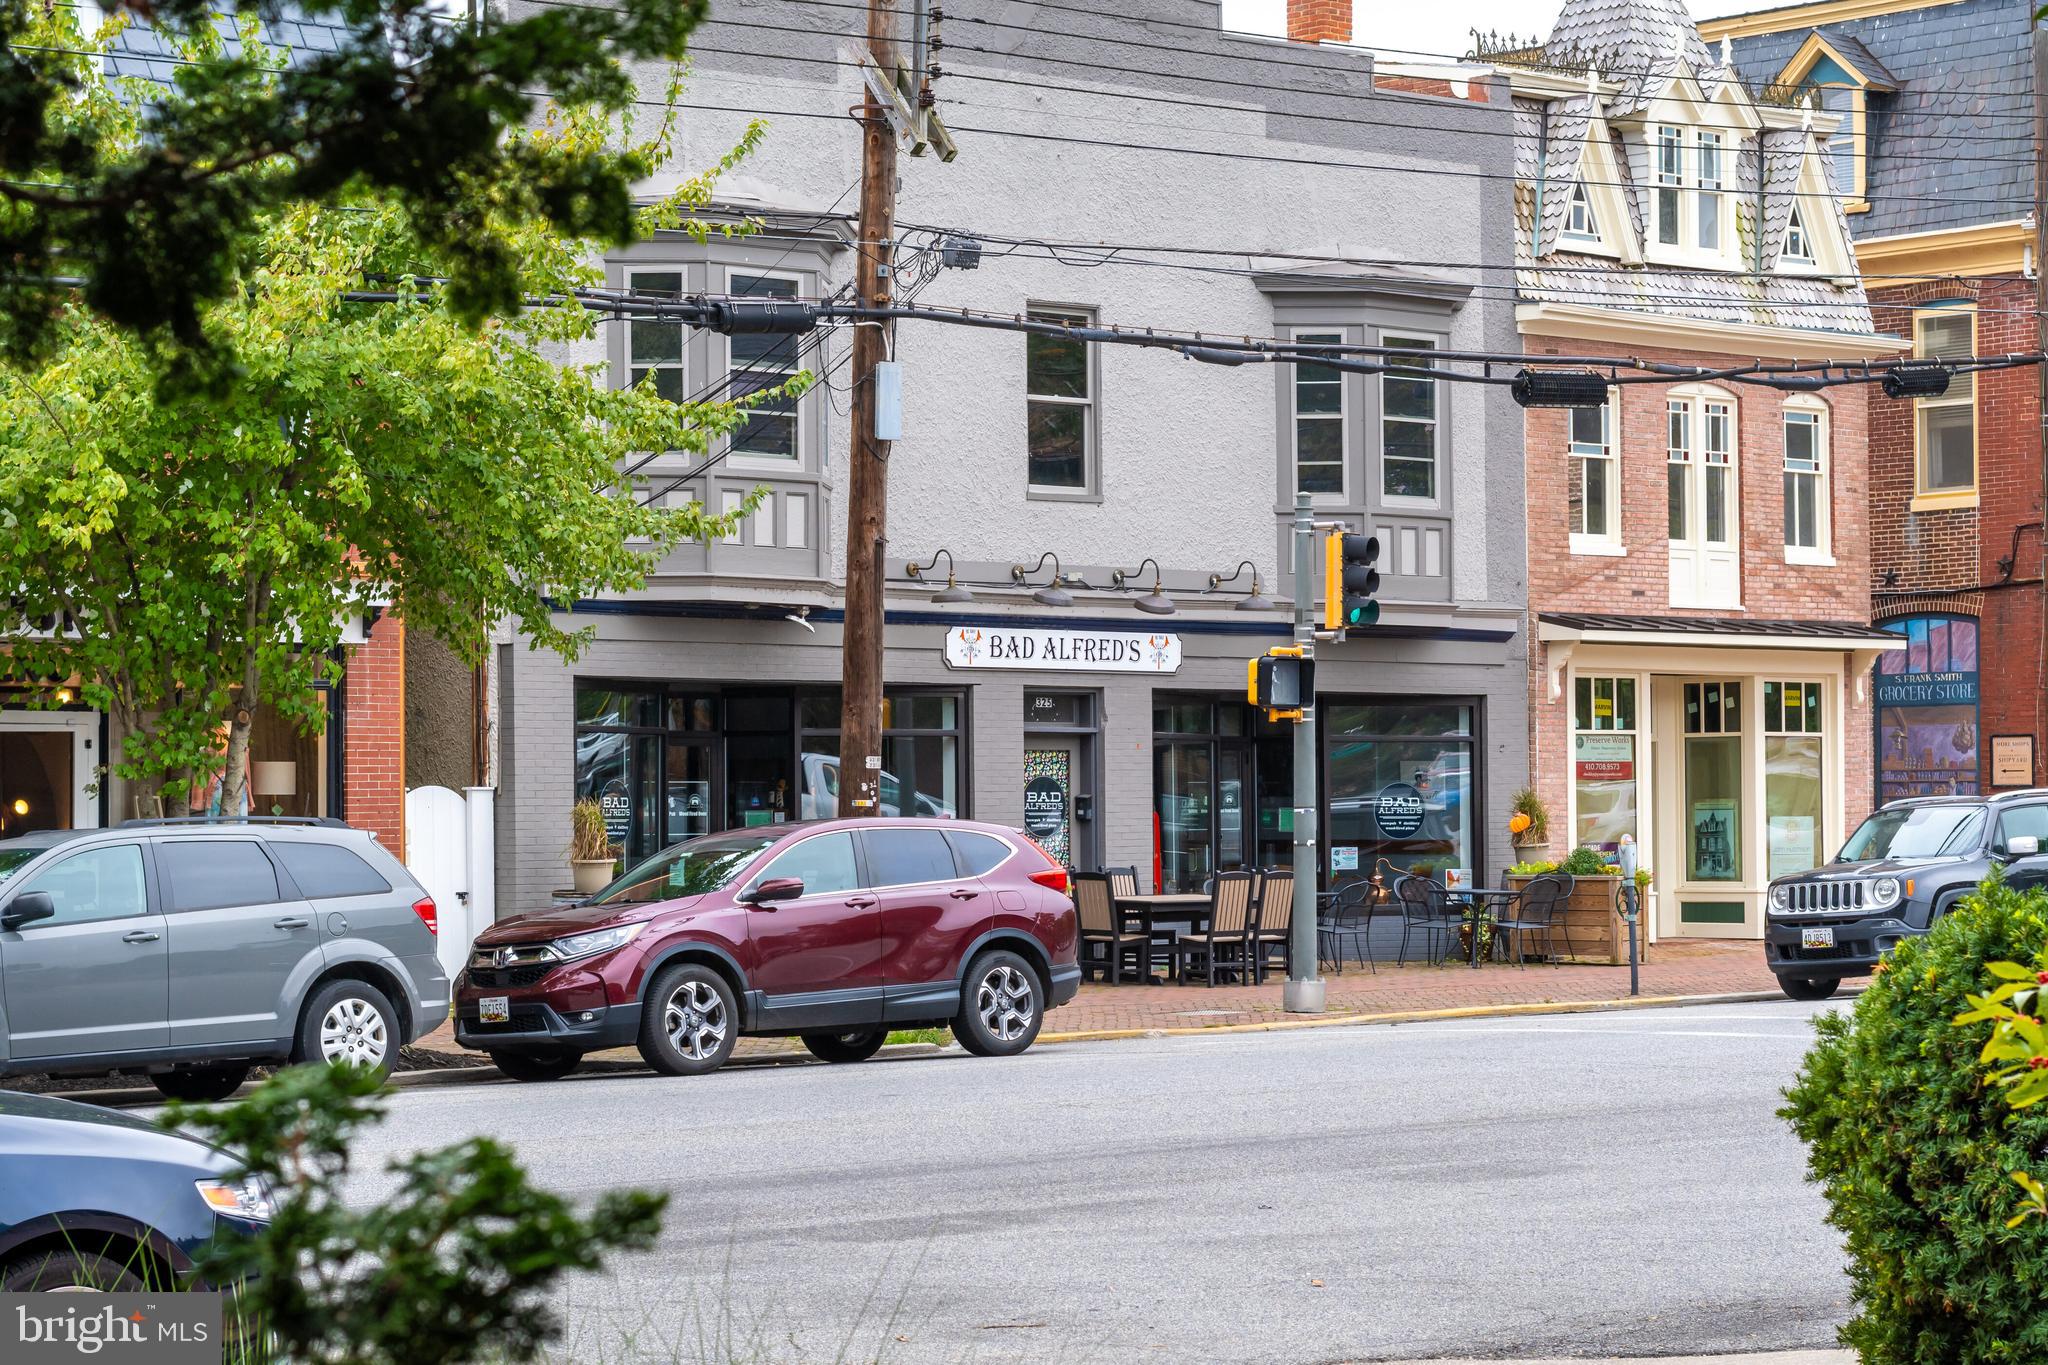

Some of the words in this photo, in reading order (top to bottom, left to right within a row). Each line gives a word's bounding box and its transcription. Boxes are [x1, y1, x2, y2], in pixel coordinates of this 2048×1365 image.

[990, 635, 1035, 659] BAD
[1042, 637, 1141, 662] ALFRED'S
[1904, 674, 1932, 682] FRANK
[1934, 673, 1963, 681] SMITH
[1879, 685, 1934, 701] GROCERY
[1936, 683, 1976, 700] STORE
[1036, 697, 1053, 708] 325
[1586, 736, 1611, 744] Preserve
[1612, 736, 1630, 744] Works
[1026, 792, 1062, 802] BAD
[1380, 797, 1420, 807] BAD
[602, 797, 629, 808] BAD
